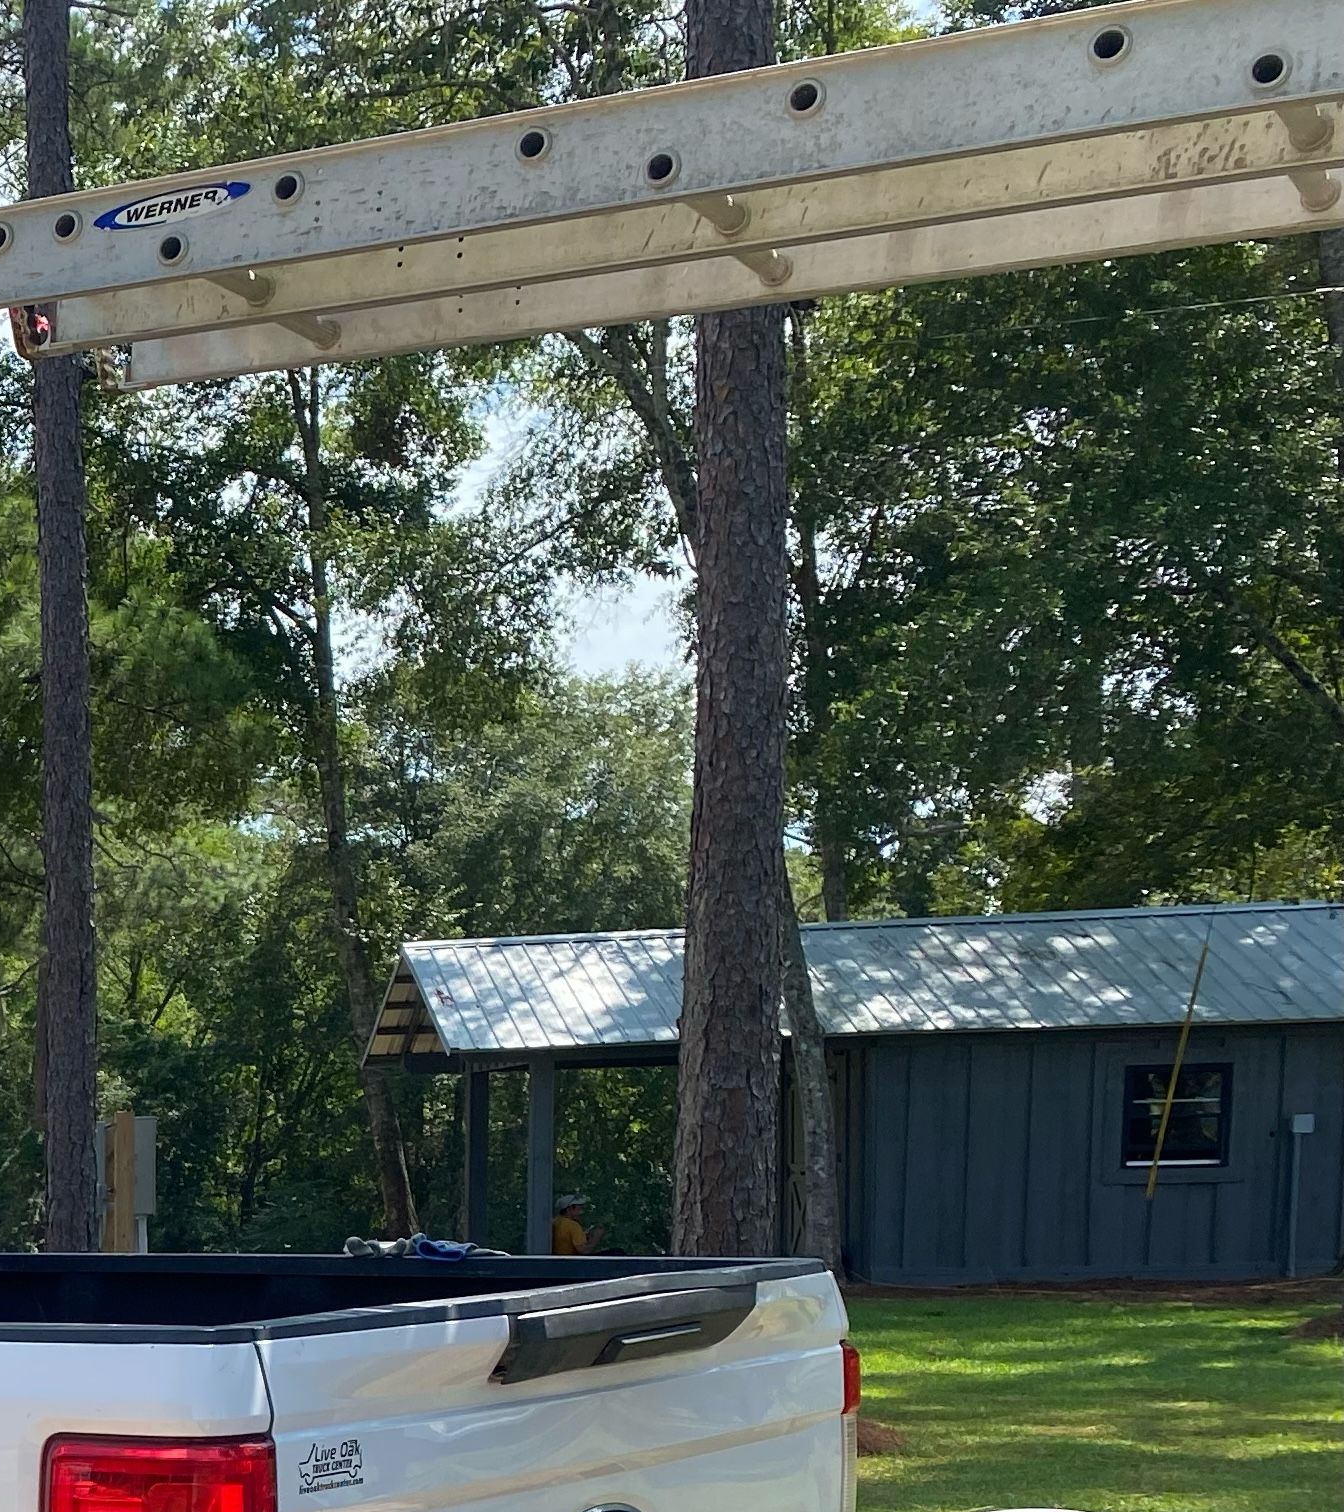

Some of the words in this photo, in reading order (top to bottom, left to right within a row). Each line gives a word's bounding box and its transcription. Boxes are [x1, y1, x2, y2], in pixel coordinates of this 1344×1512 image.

[126, 189, 222, 223] WERNER
[314, 1445, 337, 1462] Live
[340, 1441, 360, 1458] Oak
[312, 1462, 330, 1474] TRUCK
[331, 1459, 352, 1471] CENTER
